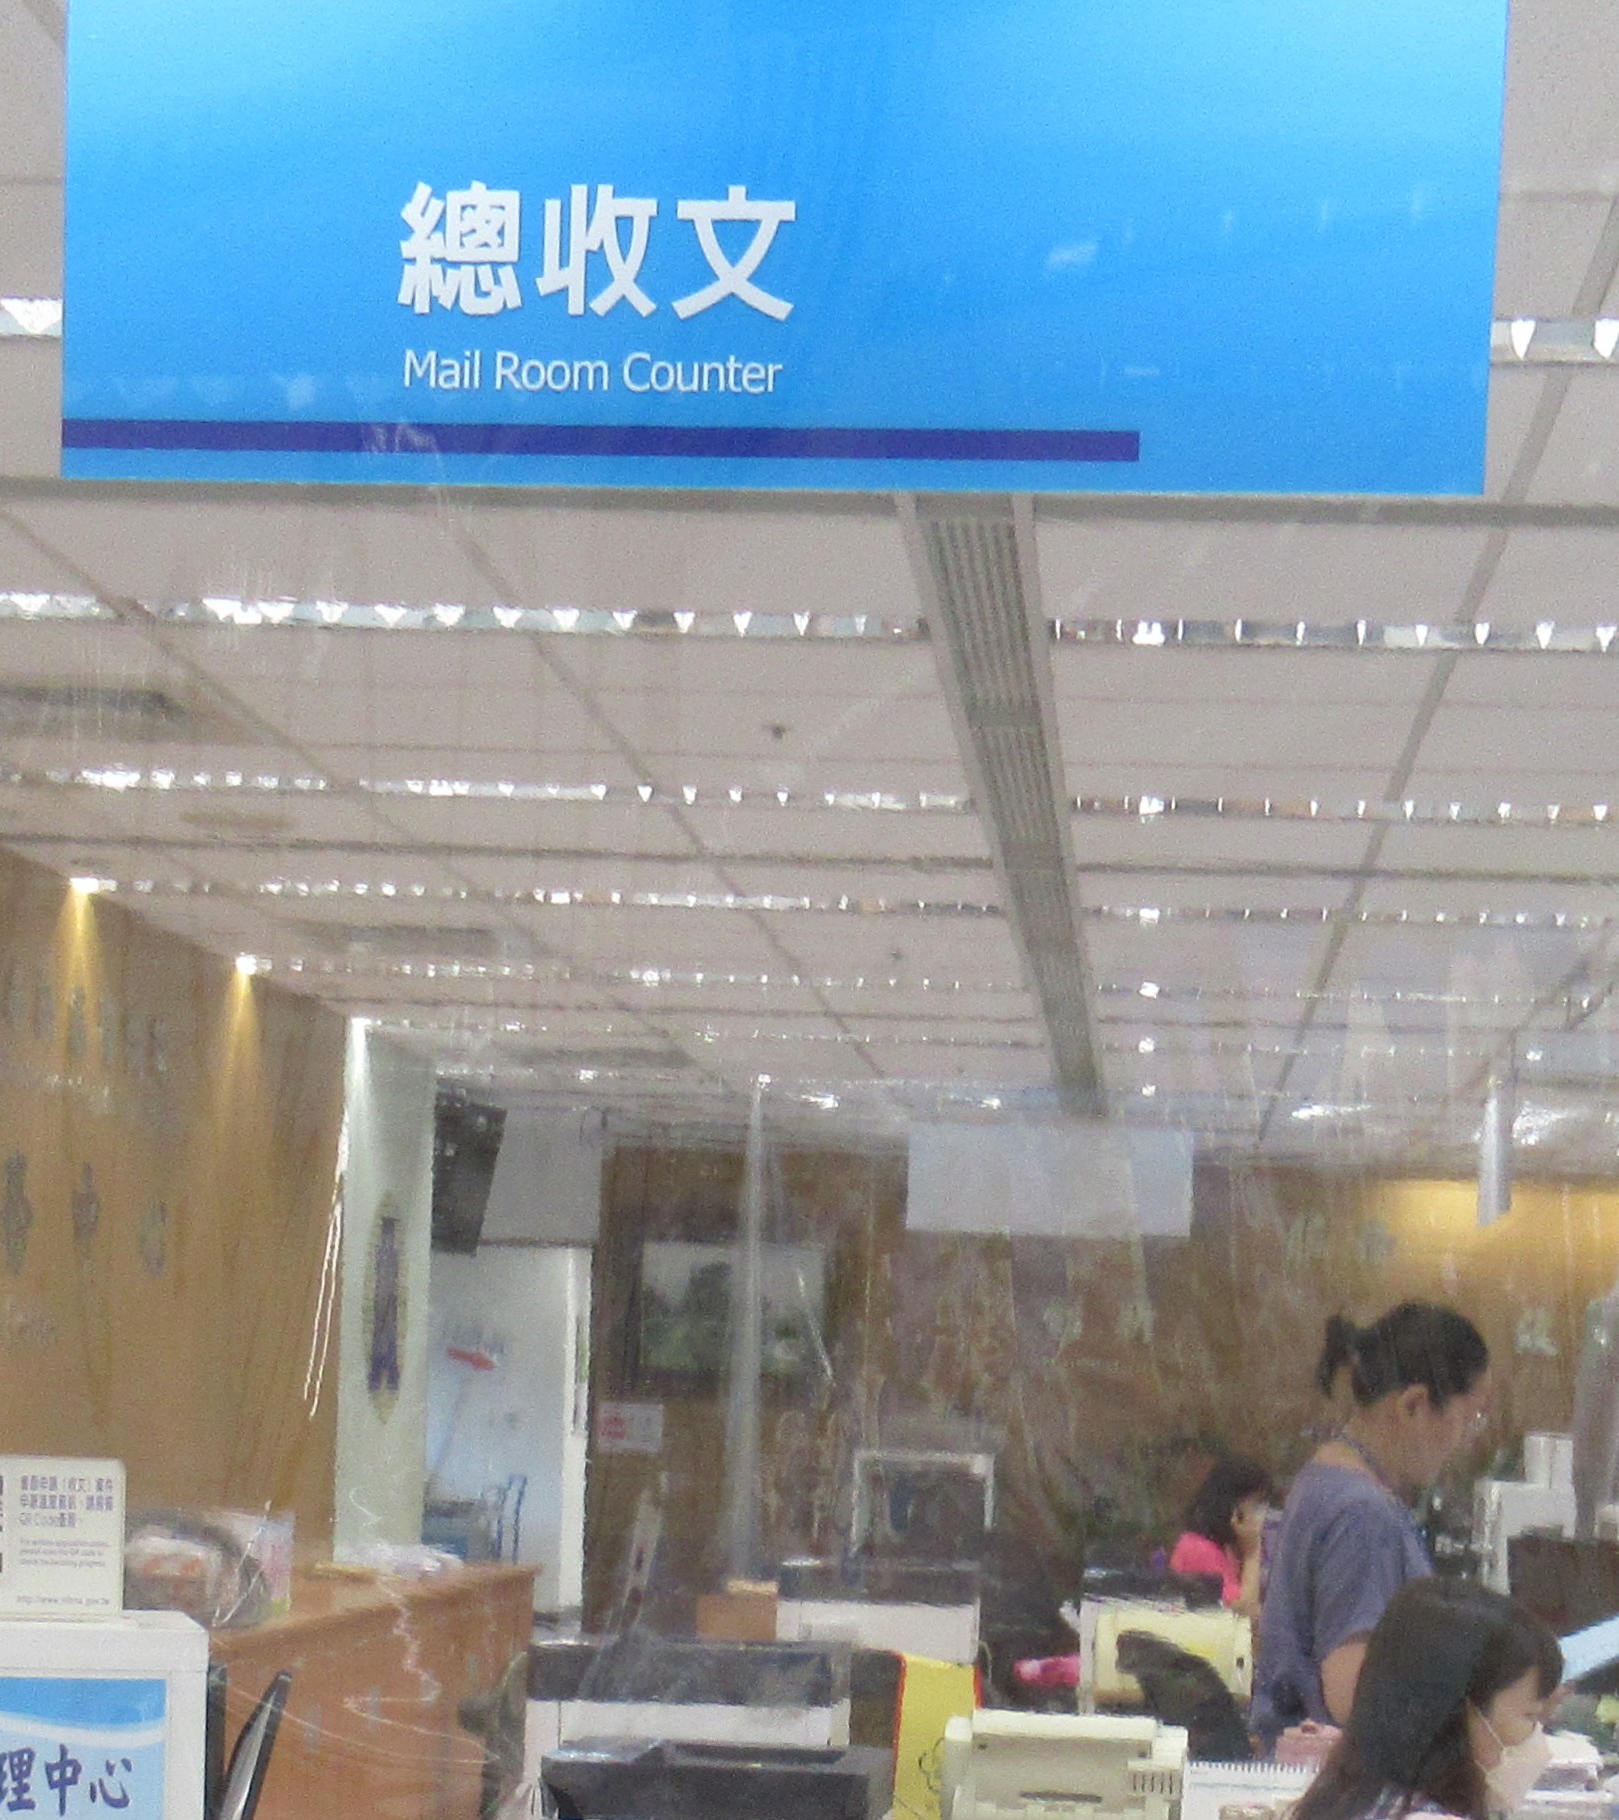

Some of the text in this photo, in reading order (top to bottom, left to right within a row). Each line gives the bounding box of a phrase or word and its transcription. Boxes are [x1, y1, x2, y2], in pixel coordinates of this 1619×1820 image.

[396, 180, 796, 320] 總收文
[402, 348, 783, 393] Mail Room Counter
